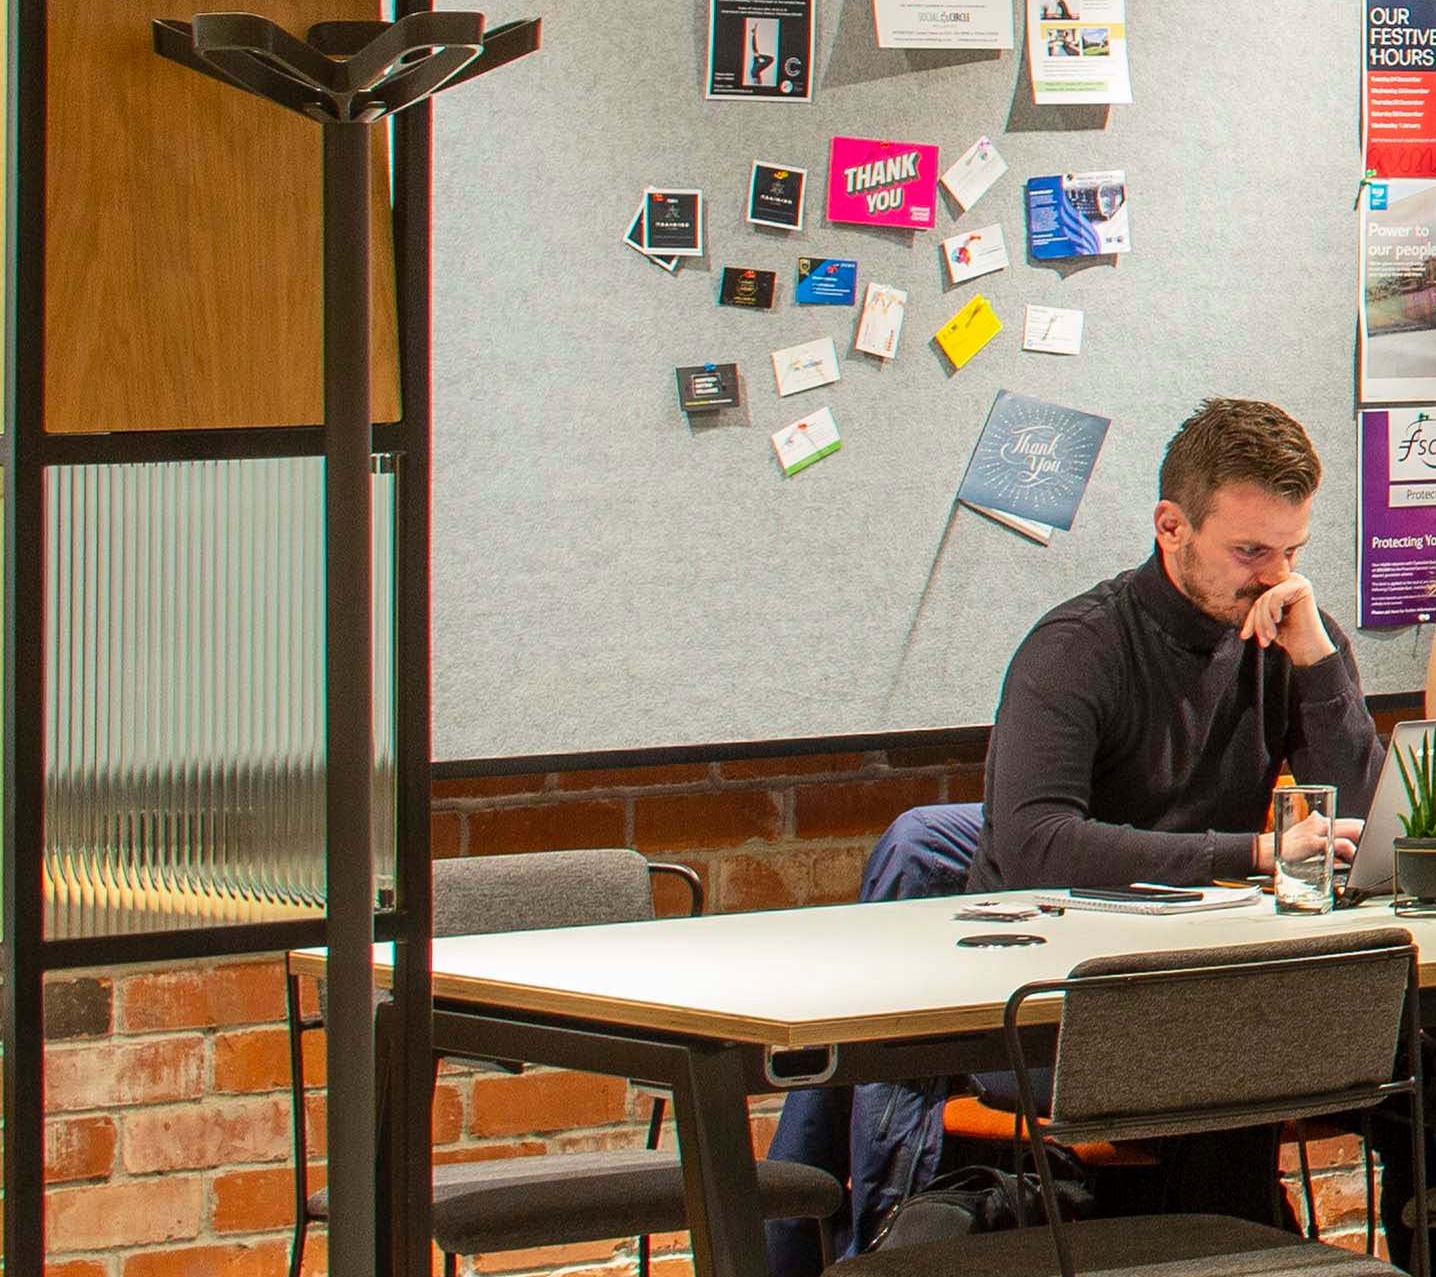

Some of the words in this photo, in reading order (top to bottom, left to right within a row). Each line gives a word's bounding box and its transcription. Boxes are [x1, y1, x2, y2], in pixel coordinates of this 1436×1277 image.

[1370, 7, 1410, 25] OUR
[1370, 48, 1435, 66] HOURS
[843, 152, 919, 194] THANK
[866, 187, 903, 214] YOU
[1368, 222, 1413, 237] Power
[1414, 225, 1430, 237] to
[1369, 245, 1392, 257] our
[1000, 425, 1064, 465] Thank
[1372, 535, 1424, 550] Protecting
